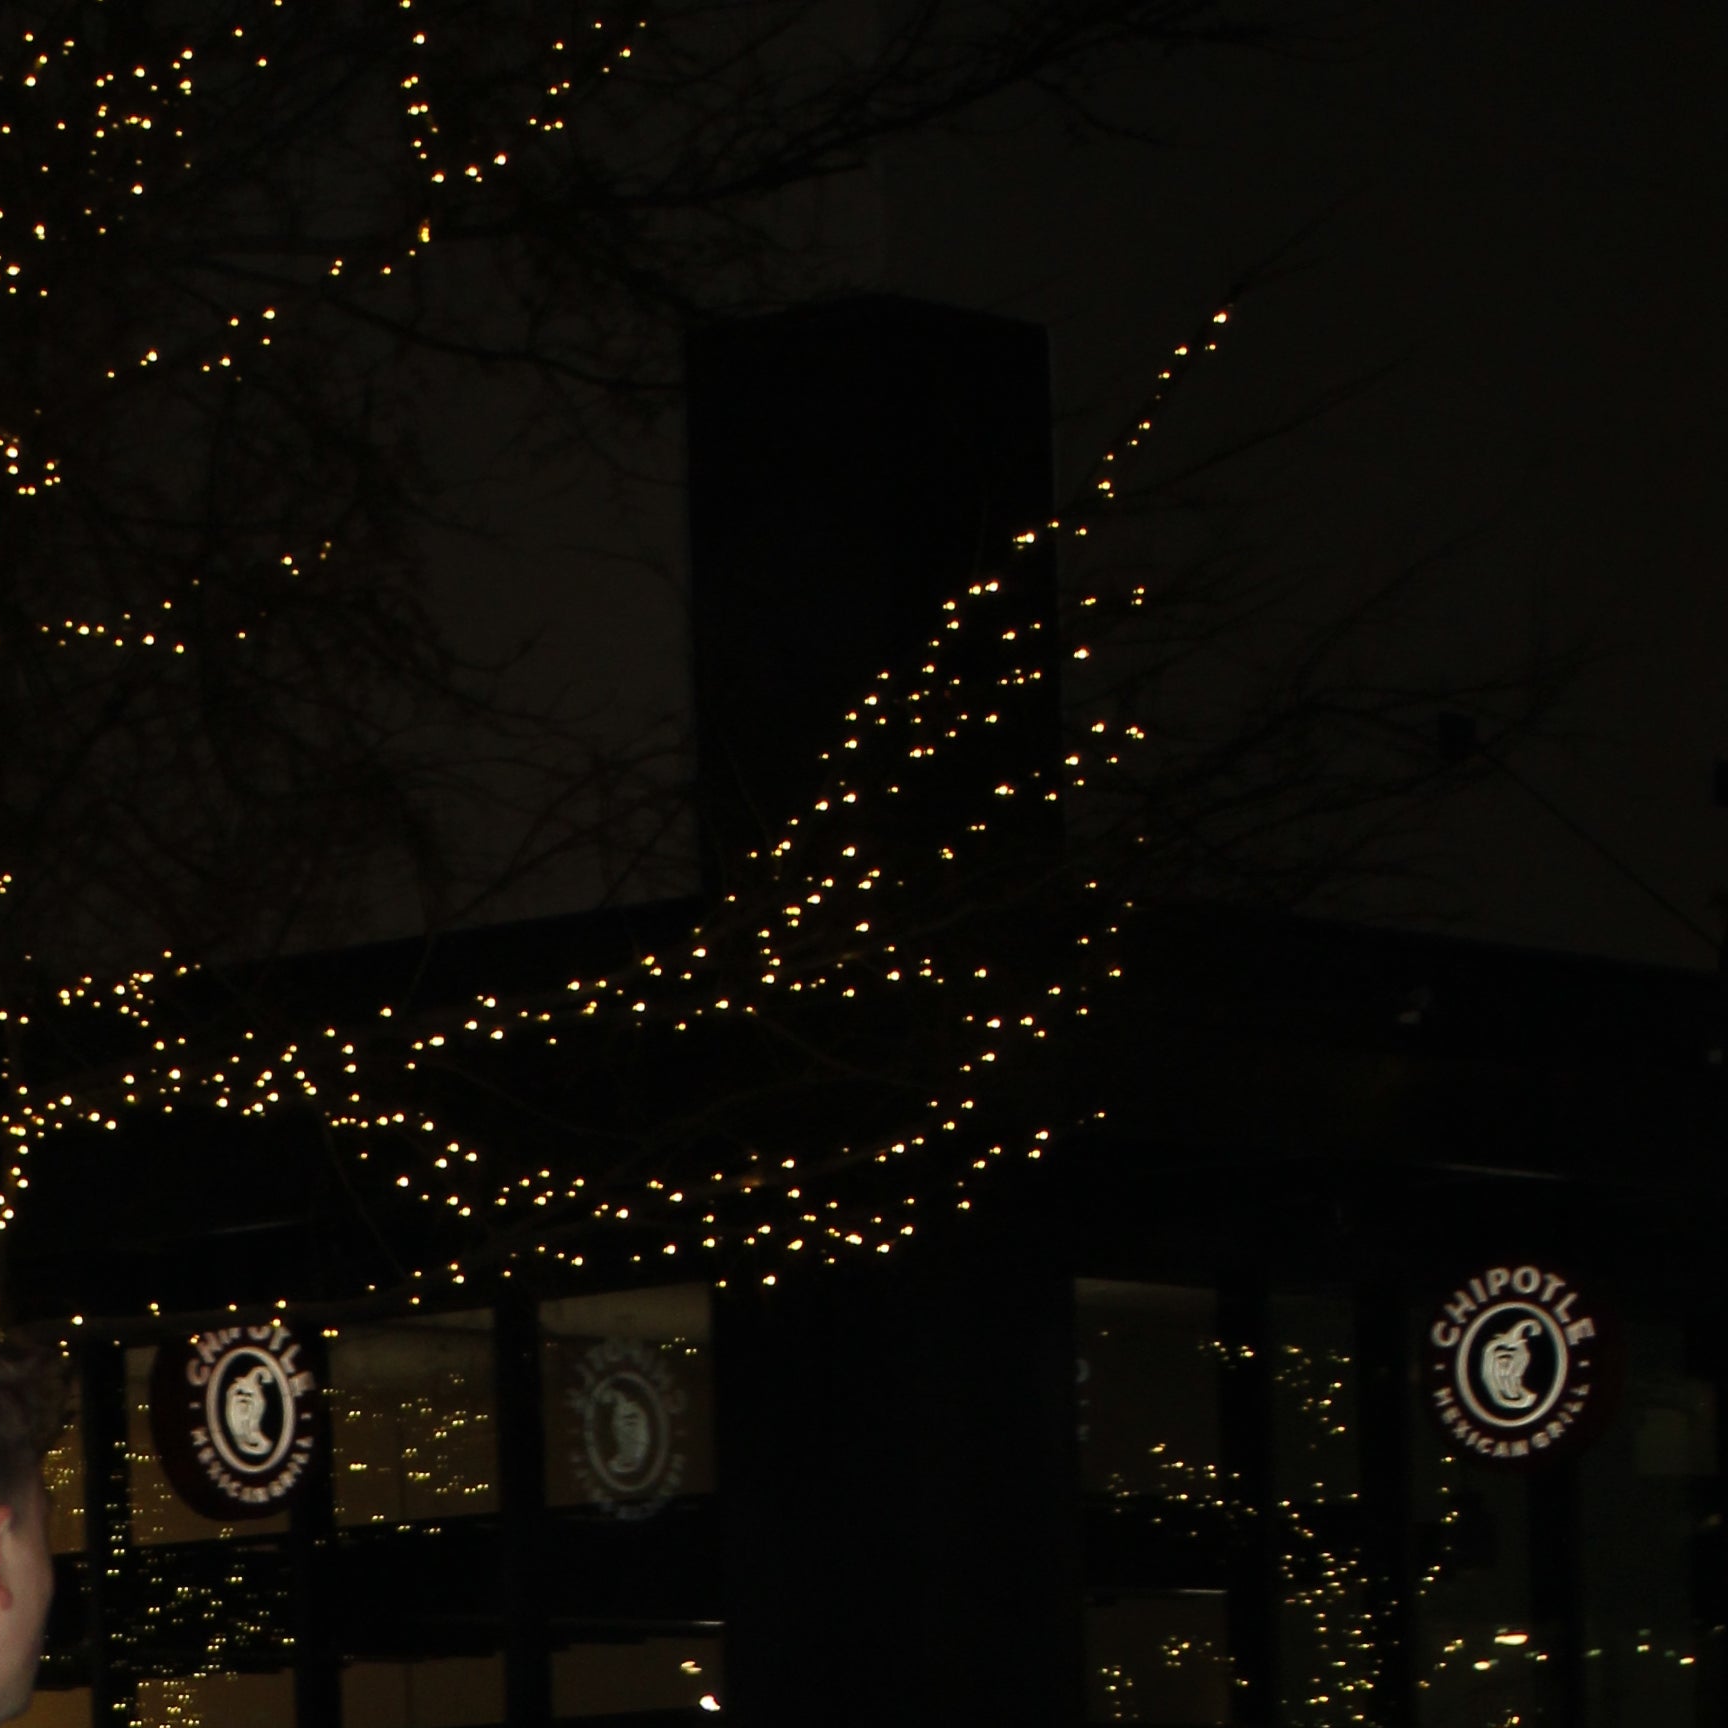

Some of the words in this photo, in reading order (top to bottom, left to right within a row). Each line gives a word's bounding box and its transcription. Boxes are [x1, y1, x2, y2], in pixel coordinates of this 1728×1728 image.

[1430, 1264, 1597, 1347] CHIPOTLE
[1432, 1385, 1531, 1458] MEXICAN
[1530, 1383, 1592, 1449] GRILL
